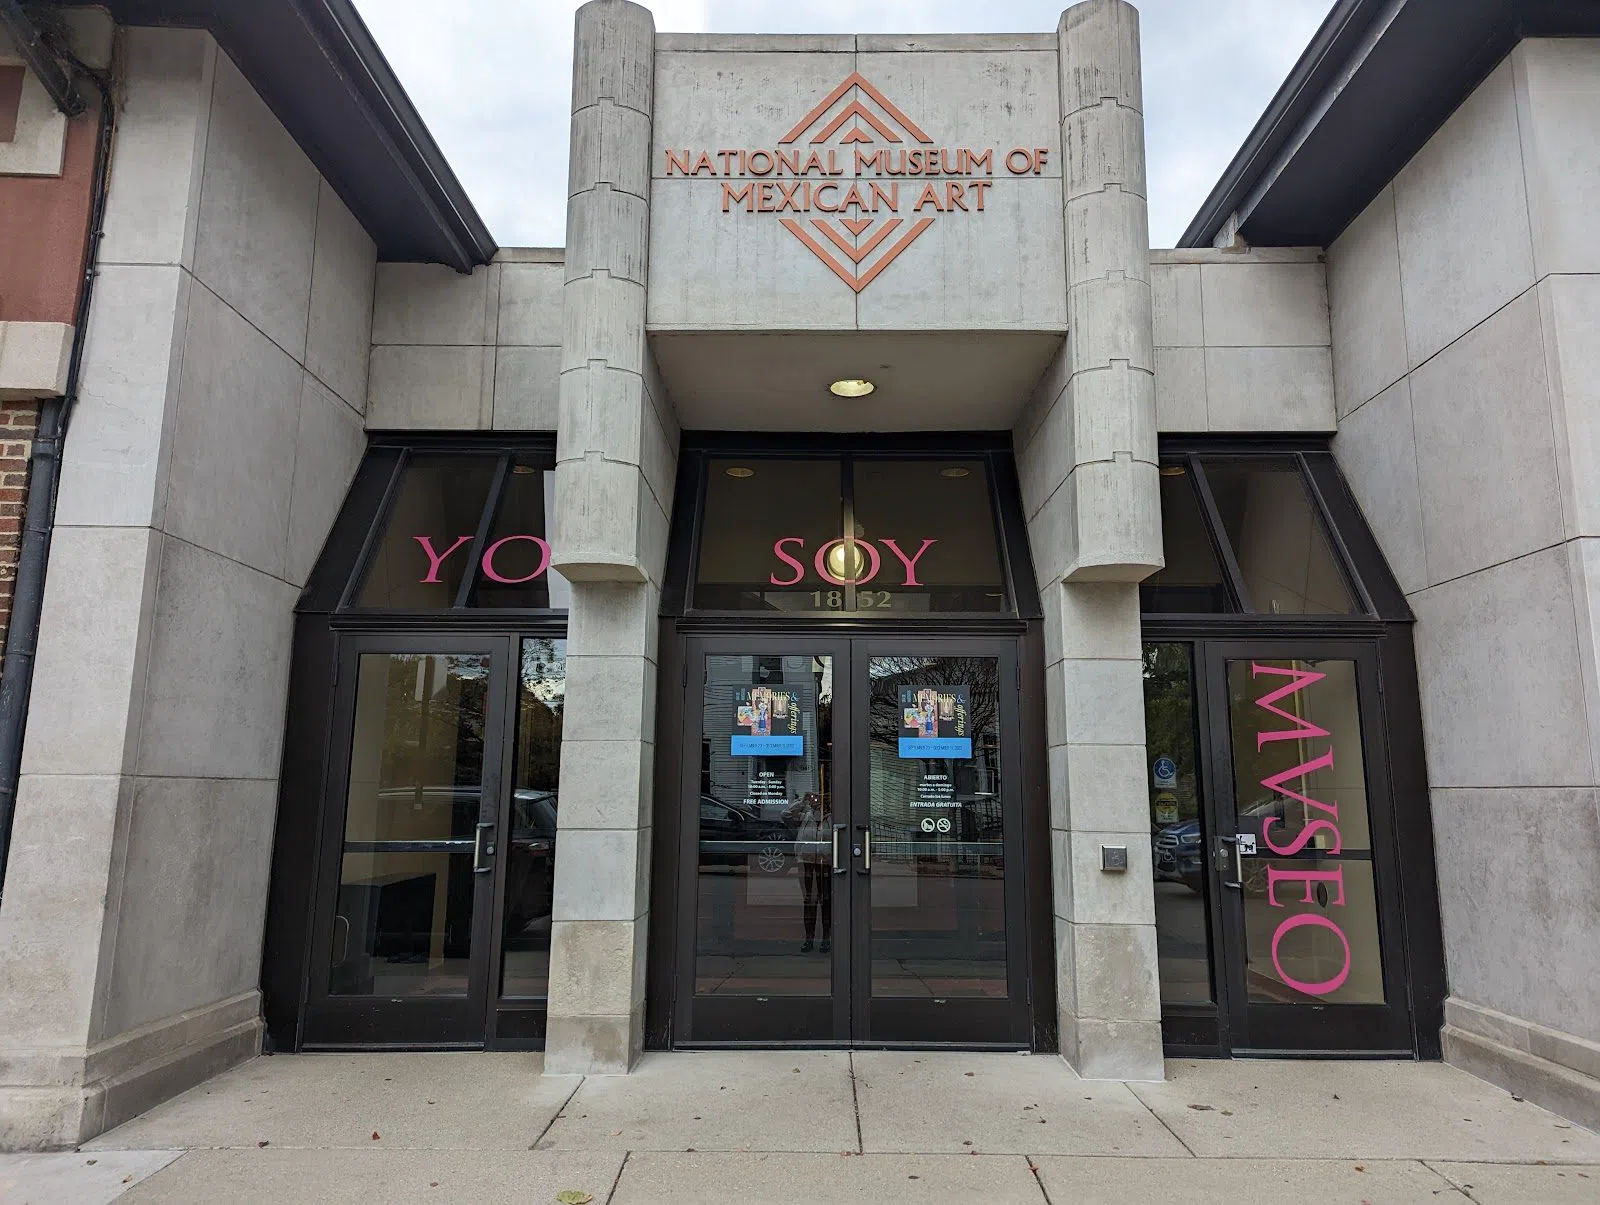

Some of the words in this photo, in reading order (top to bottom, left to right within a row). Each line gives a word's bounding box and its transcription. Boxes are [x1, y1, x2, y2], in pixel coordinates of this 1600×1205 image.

[665, 149, 843, 176] NATIONAL
[854, 148, 993, 176] MUSEUM
[1005, 148, 1049, 175] OF
[721, 182, 898, 212] MEXICAN
[914, 181, 992, 211] ART
[413, 535, 552, 583] YO
[770, 536, 938, 586] SOY
[810, 590, 892, 608] 1852
